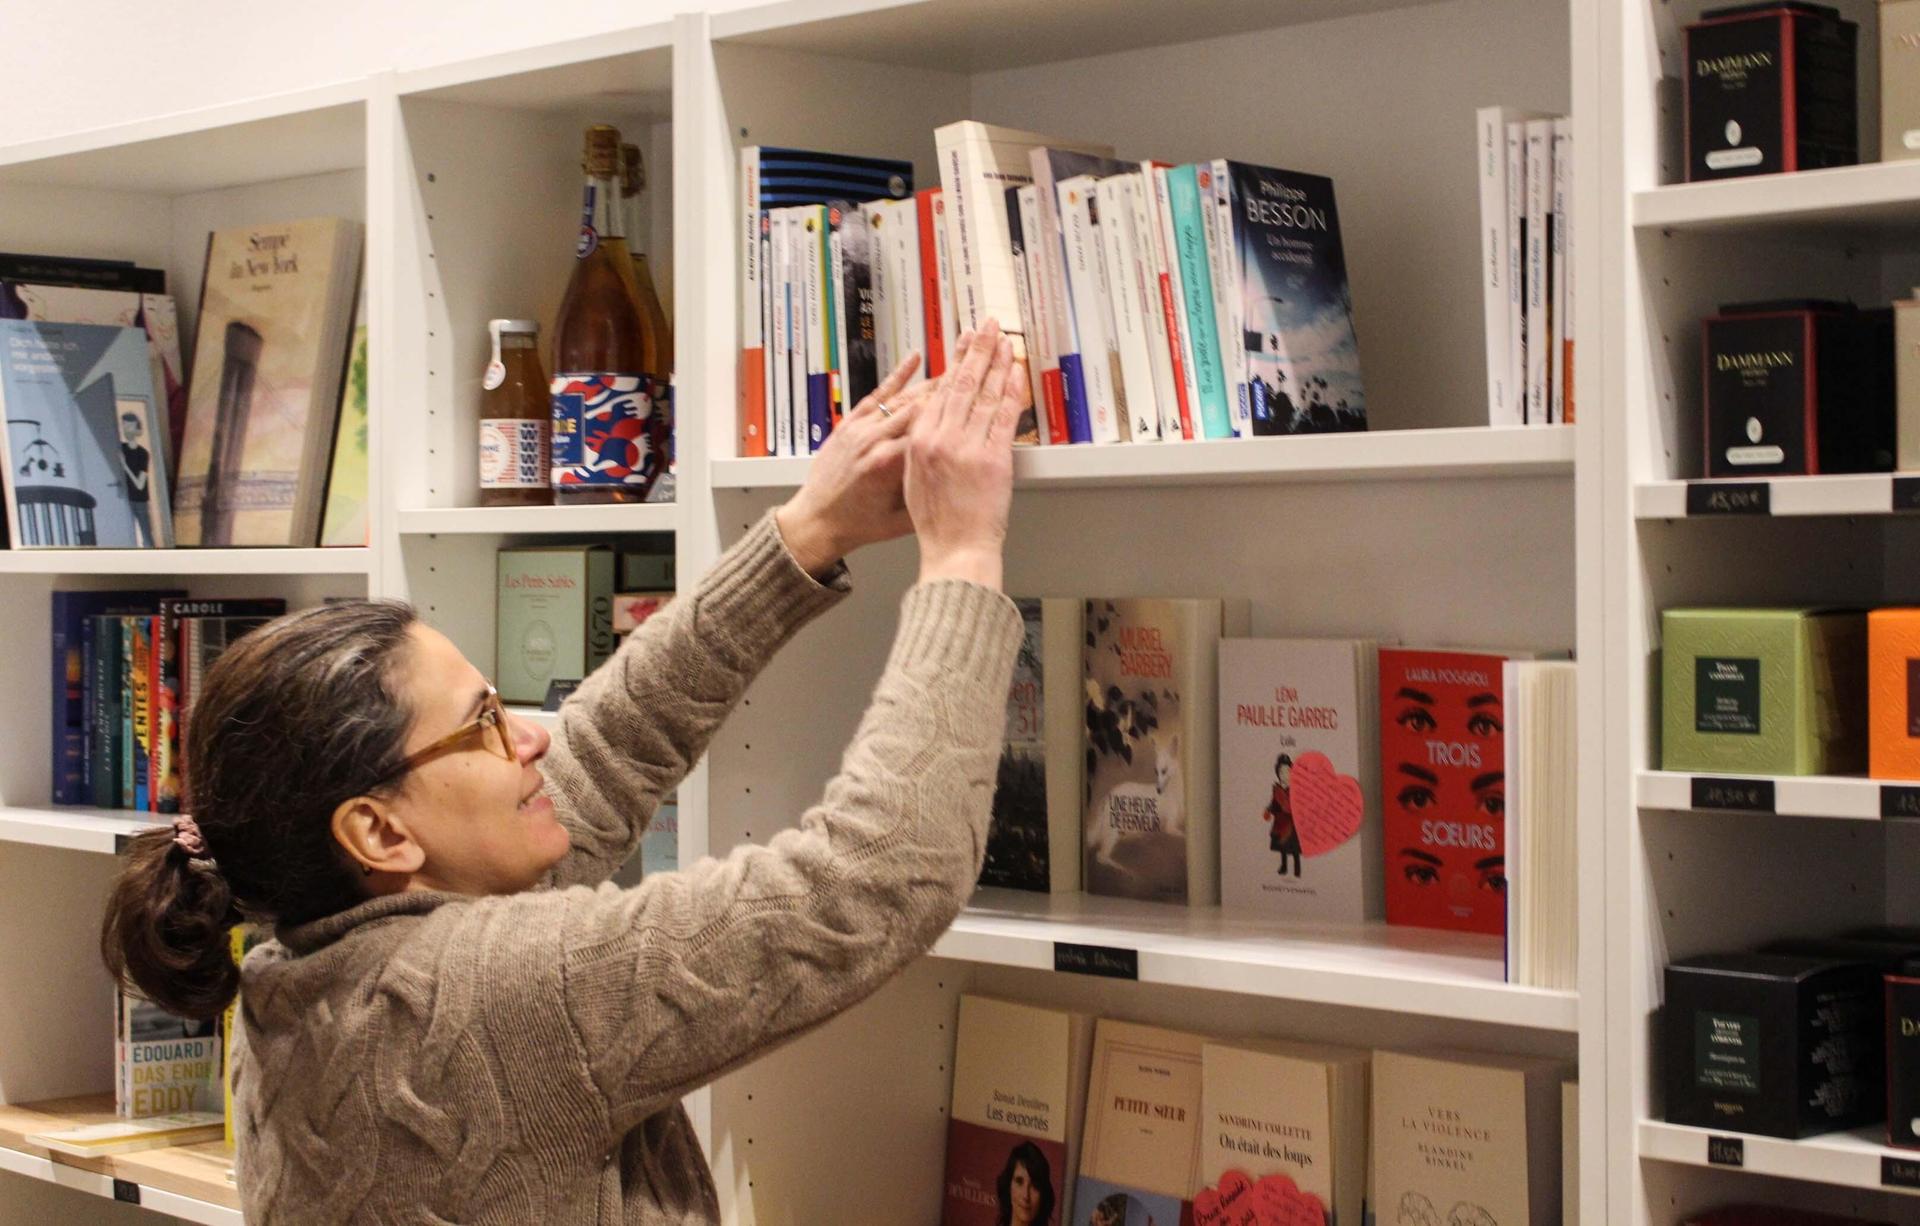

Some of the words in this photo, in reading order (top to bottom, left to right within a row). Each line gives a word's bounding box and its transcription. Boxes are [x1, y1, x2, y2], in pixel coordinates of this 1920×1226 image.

[1247, 199, 1328, 232] BESSON
[1717, 352, 1793, 371] DAMMANN
[173, 602, 224, 615] CAROLE
[1119, 653, 1173, 679] BARBERY
[1405, 667, 1435, 684] LAURA
[1288, 709, 1339, 731] GARREC
[1425, 740, 1482, 769] TROIS
[1422, 819, 1496, 850] SŒURS
[133, 1040, 204, 1063] ÉDOUARD
[134, 1065, 165, 1085] DAS
[134, 1085, 198, 1116] EDDY
[1114, 1095, 1149, 1117] PETITE
[1427, 1105, 1461, 1122] VERS
[987, 1103, 1004, 1123] Les
[1006, 1109, 1049, 1133] exportés
[1218, 1111, 1264, 1133] SANDRINE
[1264, 1120, 1312, 1142] COLLETTE
[1402, 1116, 1417, 1130] LA
[1422, 1119, 1493, 1143] VIOLENCE
[1219, 1132, 1237, 1151] On
[1237, 1135, 1261, 1157] était
[1263, 1139, 1282, 1160] des
[1283, 1145, 1313, 1168] loups
